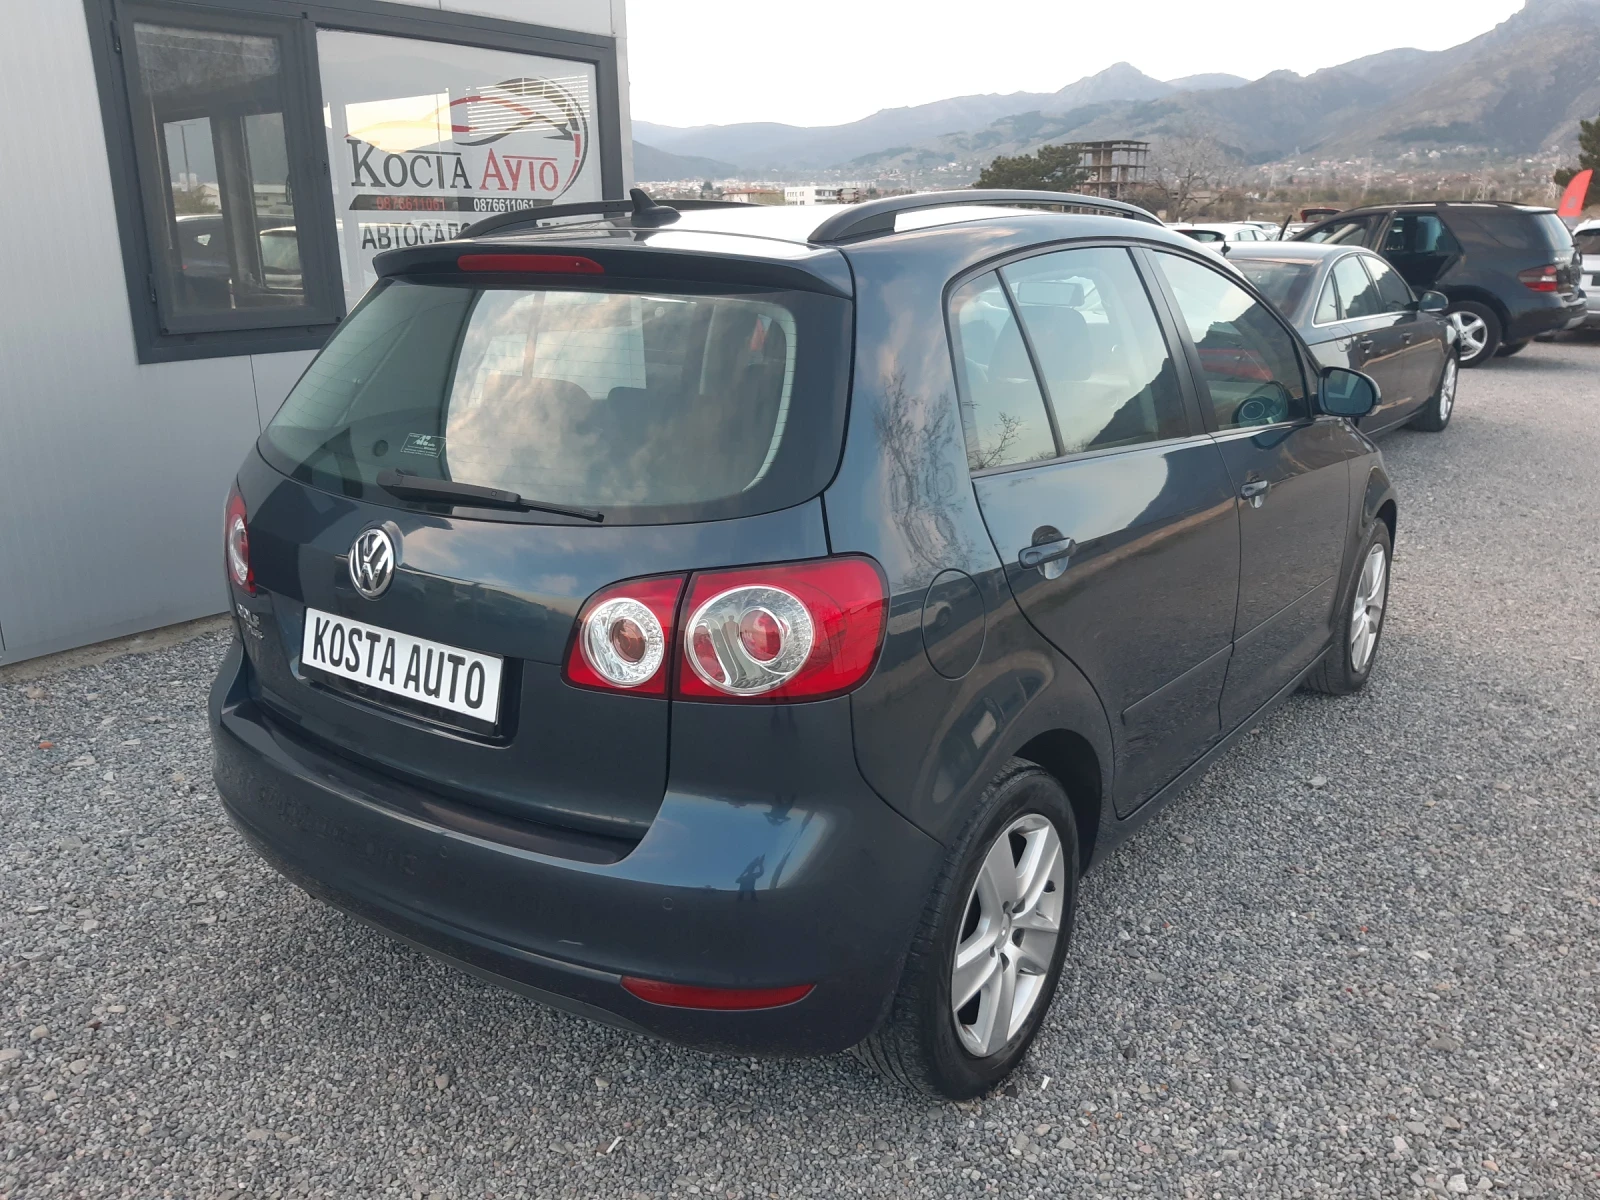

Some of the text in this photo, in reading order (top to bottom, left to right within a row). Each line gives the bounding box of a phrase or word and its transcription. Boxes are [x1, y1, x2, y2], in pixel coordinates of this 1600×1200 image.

[473, 198, 534, 213] 0876611061
[361, 222, 471, 250] АВТОСАЛ
[312, 616, 486, 709] KOSTA AUTO
